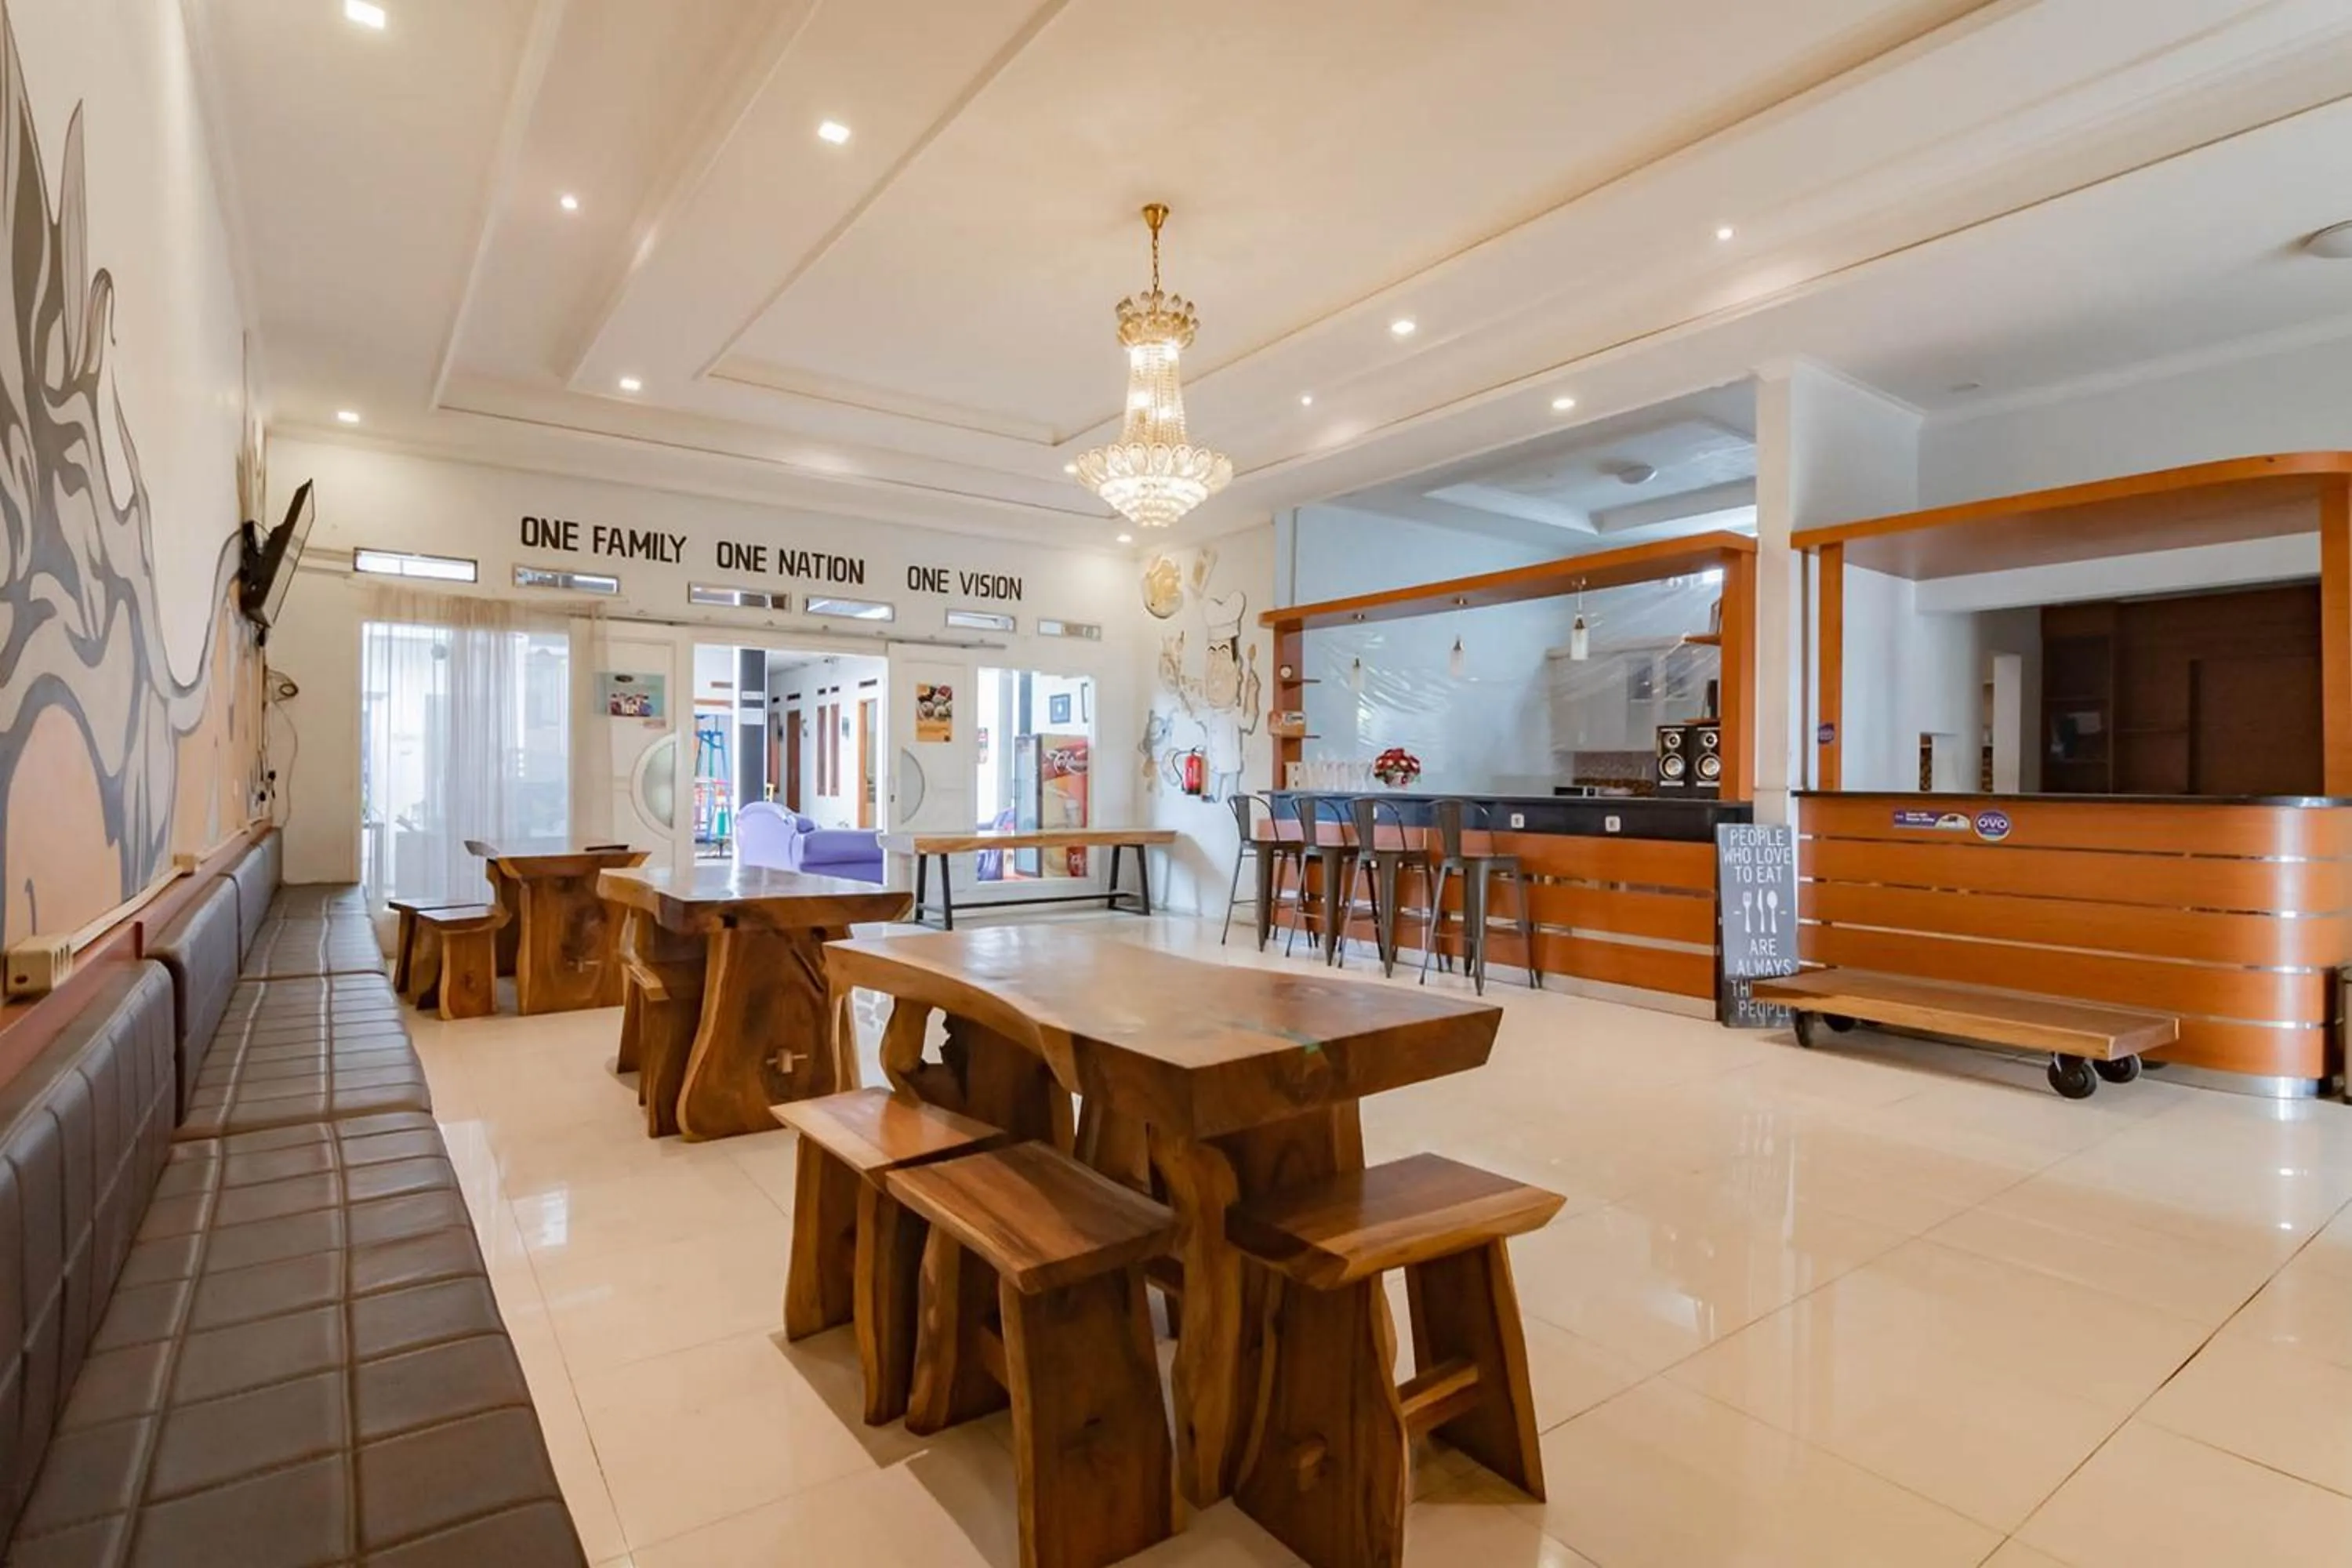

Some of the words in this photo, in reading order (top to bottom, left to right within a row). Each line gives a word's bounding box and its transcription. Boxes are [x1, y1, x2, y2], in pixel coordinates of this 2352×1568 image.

[520, 516, 579, 552] ONE
[593, 524, 688, 564] FAMILY
[717, 540, 768, 573] ONE
[778, 548, 865, 585] NATION
[907, 565, 949, 593] ONE
[959, 571, 1022, 601] VISION
[1730, 829, 1785, 846] PEOPLE
[1723, 847, 1751, 865] WHO
[1756, 847, 1791, 865] LOVE
[1734, 865, 1752, 884] TO
[1757, 865, 1782, 884] EAT
[1748, 938, 1777, 956] ARE
[1736, 958, 1792, 976] ALWAYS
